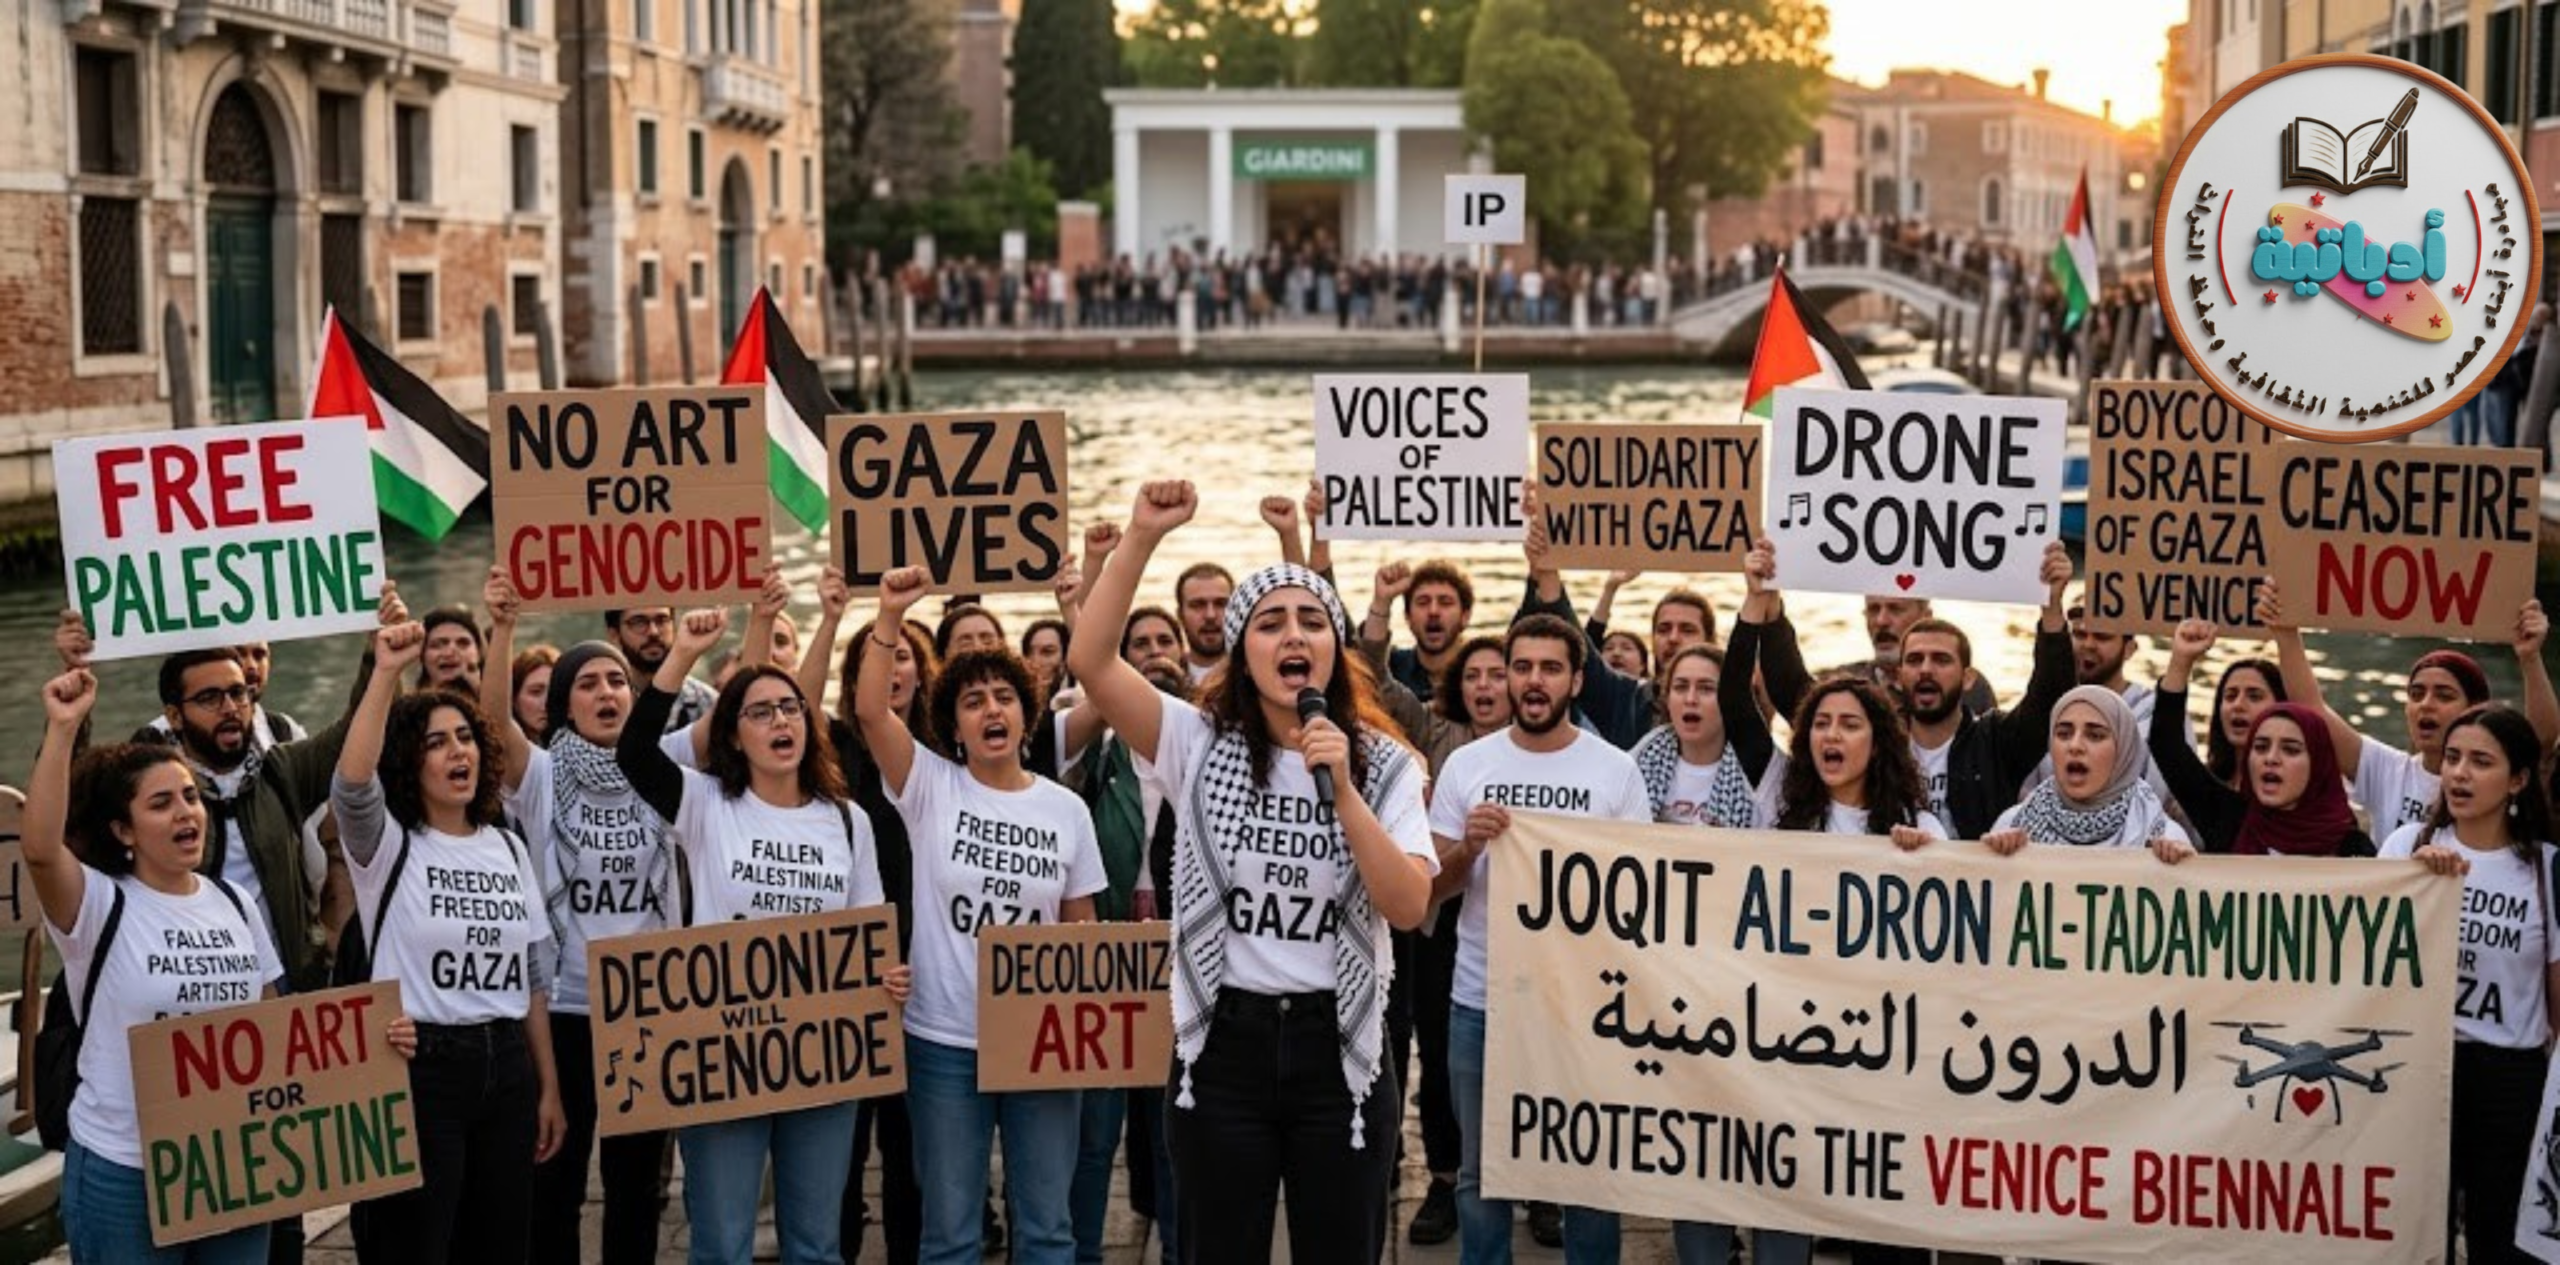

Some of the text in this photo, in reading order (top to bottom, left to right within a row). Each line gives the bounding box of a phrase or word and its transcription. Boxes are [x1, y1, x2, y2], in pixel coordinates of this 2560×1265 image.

[1244, 147, 1364, 171] GIARDINI
[1464, 192, 1506, 226] IP
[507, 397, 752, 471] NO ART
[1330, 386, 1489, 438] VOICES
[2098, 387, 2271, 445] BOYCO
[839, 419, 1058, 499] GAZA
[1399, 444, 1441, 469] OF
[1543, 436, 1759, 490] SOLIDARITY
[1795, 407, 2039, 488] DRONE
[96, 434, 313, 539] FREE
[586, 475, 671, 516] FOR
[1324, 475, 1524, 528] PALESTINE
[2107, 449, 2265, 505] ISRAEL
[2280, 456, 2535, 542] CEASEFIRE
[841, 502, 1061, 587] LIVES
[1544, 498, 1753, 552] WITH GAZA
[1819, 493, 2006, 571] SONG
[2094, 510, 2266, 567] OF GAZA
[74, 530, 382, 641] PALESTINE
[509, 516, 764, 600] GENOCIDE
[2316, 542, 2493, 626] NOW
[2093, 572, 2266, 628] IS VENICE
[1484, 784, 1590, 811] FREEDOM
[752, 839, 823, 866] FALLEN
[956, 810, 1058, 853] FREEDOM
[601, 855, 636, 873] FOR
[952, 839, 1058, 881] FREEDOM
[981, 876, 1021, 899] FOR
[1264, 862, 1309, 889] FOR
[569, 877, 662, 916] GAZA
[751, 891, 823, 914] ARTISTS
[1227, 886, 1341, 943] GAZA
[1517, 849, 2423, 988] JOQIT AL-DRON AL-TADAMUNIYYA
[466, 926, 502, 947] FOR
[177, 981, 249, 1003] ARTISTS
[431, 950, 523, 991] GAZA
[600, 921, 889, 1023] DECOLONIZE
[992, 940, 1170, 996] DECOLONIZ
[721, 1003, 787, 1029] WILL
[1029, 1002, 1148, 1073] ART
[1592, 970, 2186, 1105] الدرون التضامنية
[172, 995, 373, 1098] NO ART
[661, 1011, 892, 1106] GENOCIDE
[248, 1082, 305, 1115] FOR
[151, 1092, 416, 1227] PALESTINE
[1511, 1093, 2396, 1240] PROTESTING THE VENICE BIENNALE
